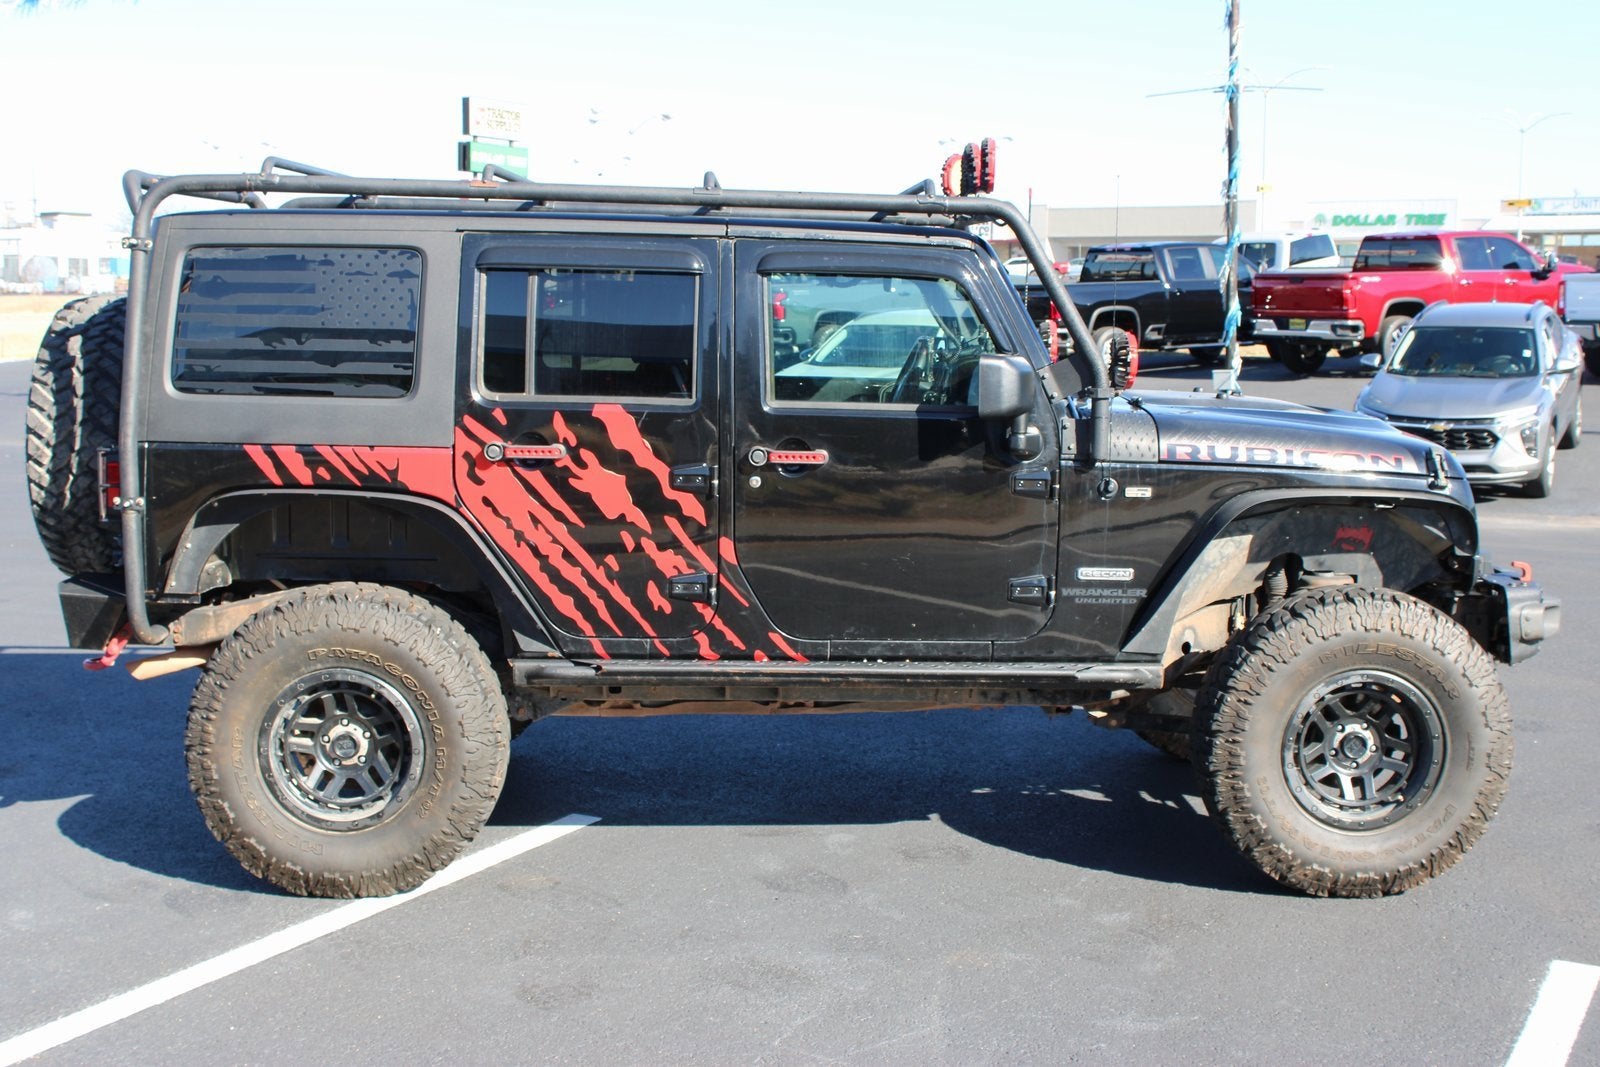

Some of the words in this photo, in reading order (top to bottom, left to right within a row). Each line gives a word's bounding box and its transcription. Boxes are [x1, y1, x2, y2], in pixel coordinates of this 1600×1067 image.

[1331, 214, 1397, 226] DOLLAR
[1404, 213, 1447, 226] TREE
[1160, 442, 1404, 471] RUBICON
[1061, 587, 1147, 598] WRANGLER
[307, 647, 444, 740] PATAGONIA
